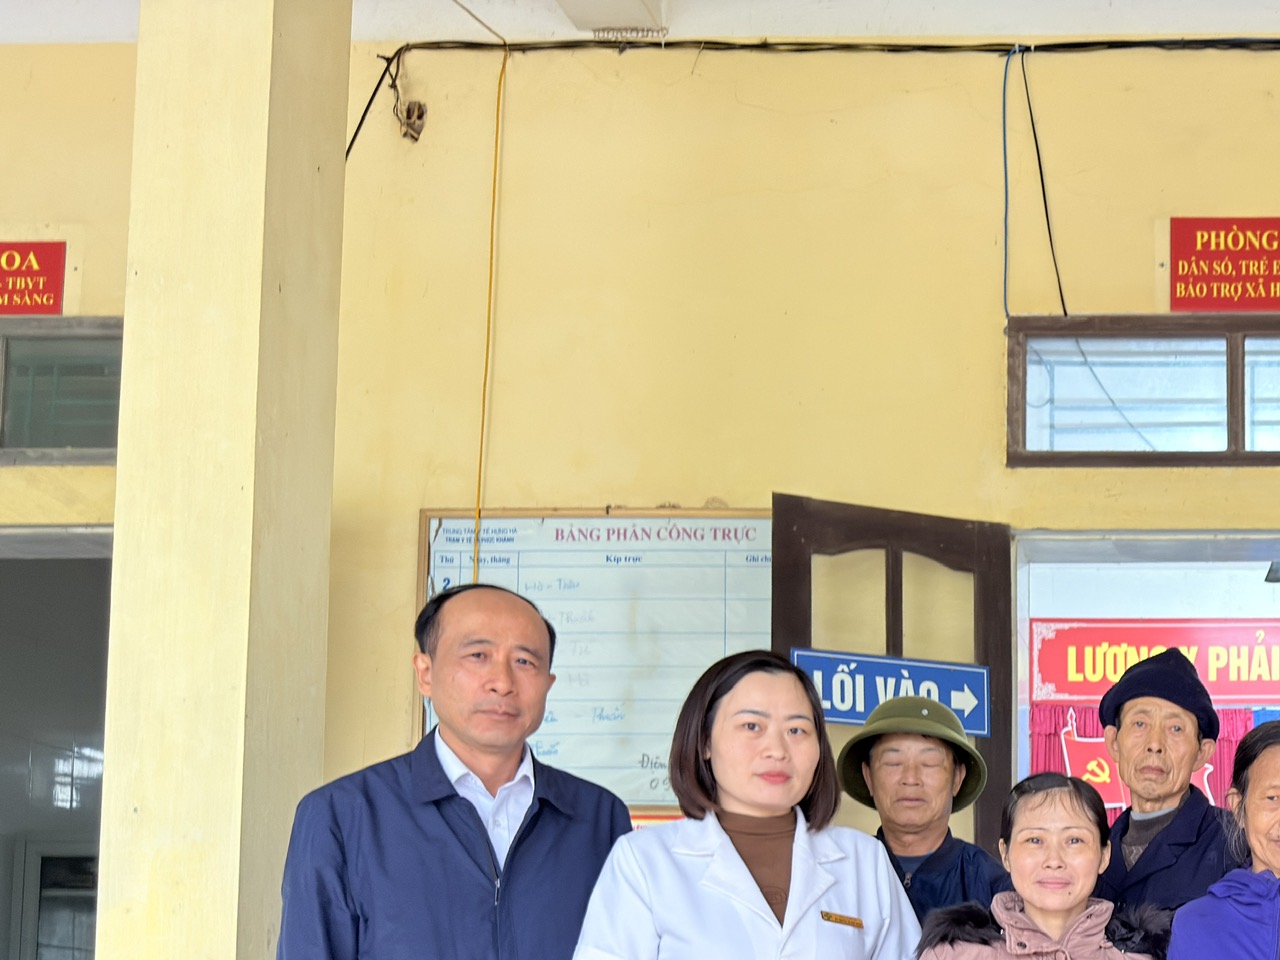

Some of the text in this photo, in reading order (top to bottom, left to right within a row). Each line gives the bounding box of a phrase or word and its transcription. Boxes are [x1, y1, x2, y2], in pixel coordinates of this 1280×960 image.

[1196, 225, 1279, 251] PHÒNG
[1178, 256, 1209, 275] DÂN
[1239, 256, 1269, 275] TRẺ
[1176, 278, 1208, 298] BẢO
[1210, 282, 1243, 302] TRỢ
[1246, 278, 1266, 298] XÃ
[555, 523, 757, 544] BẢNG PHÂN CÔNG TRỰC
[469, 556, 488, 565] Này,
[442, 577, 451, 591] 2
[1067, 642, 1168, 682] LƯƠ
[1208, 629, 1280, 682] PHẢI
[813, 662, 865, 712] LỐI
